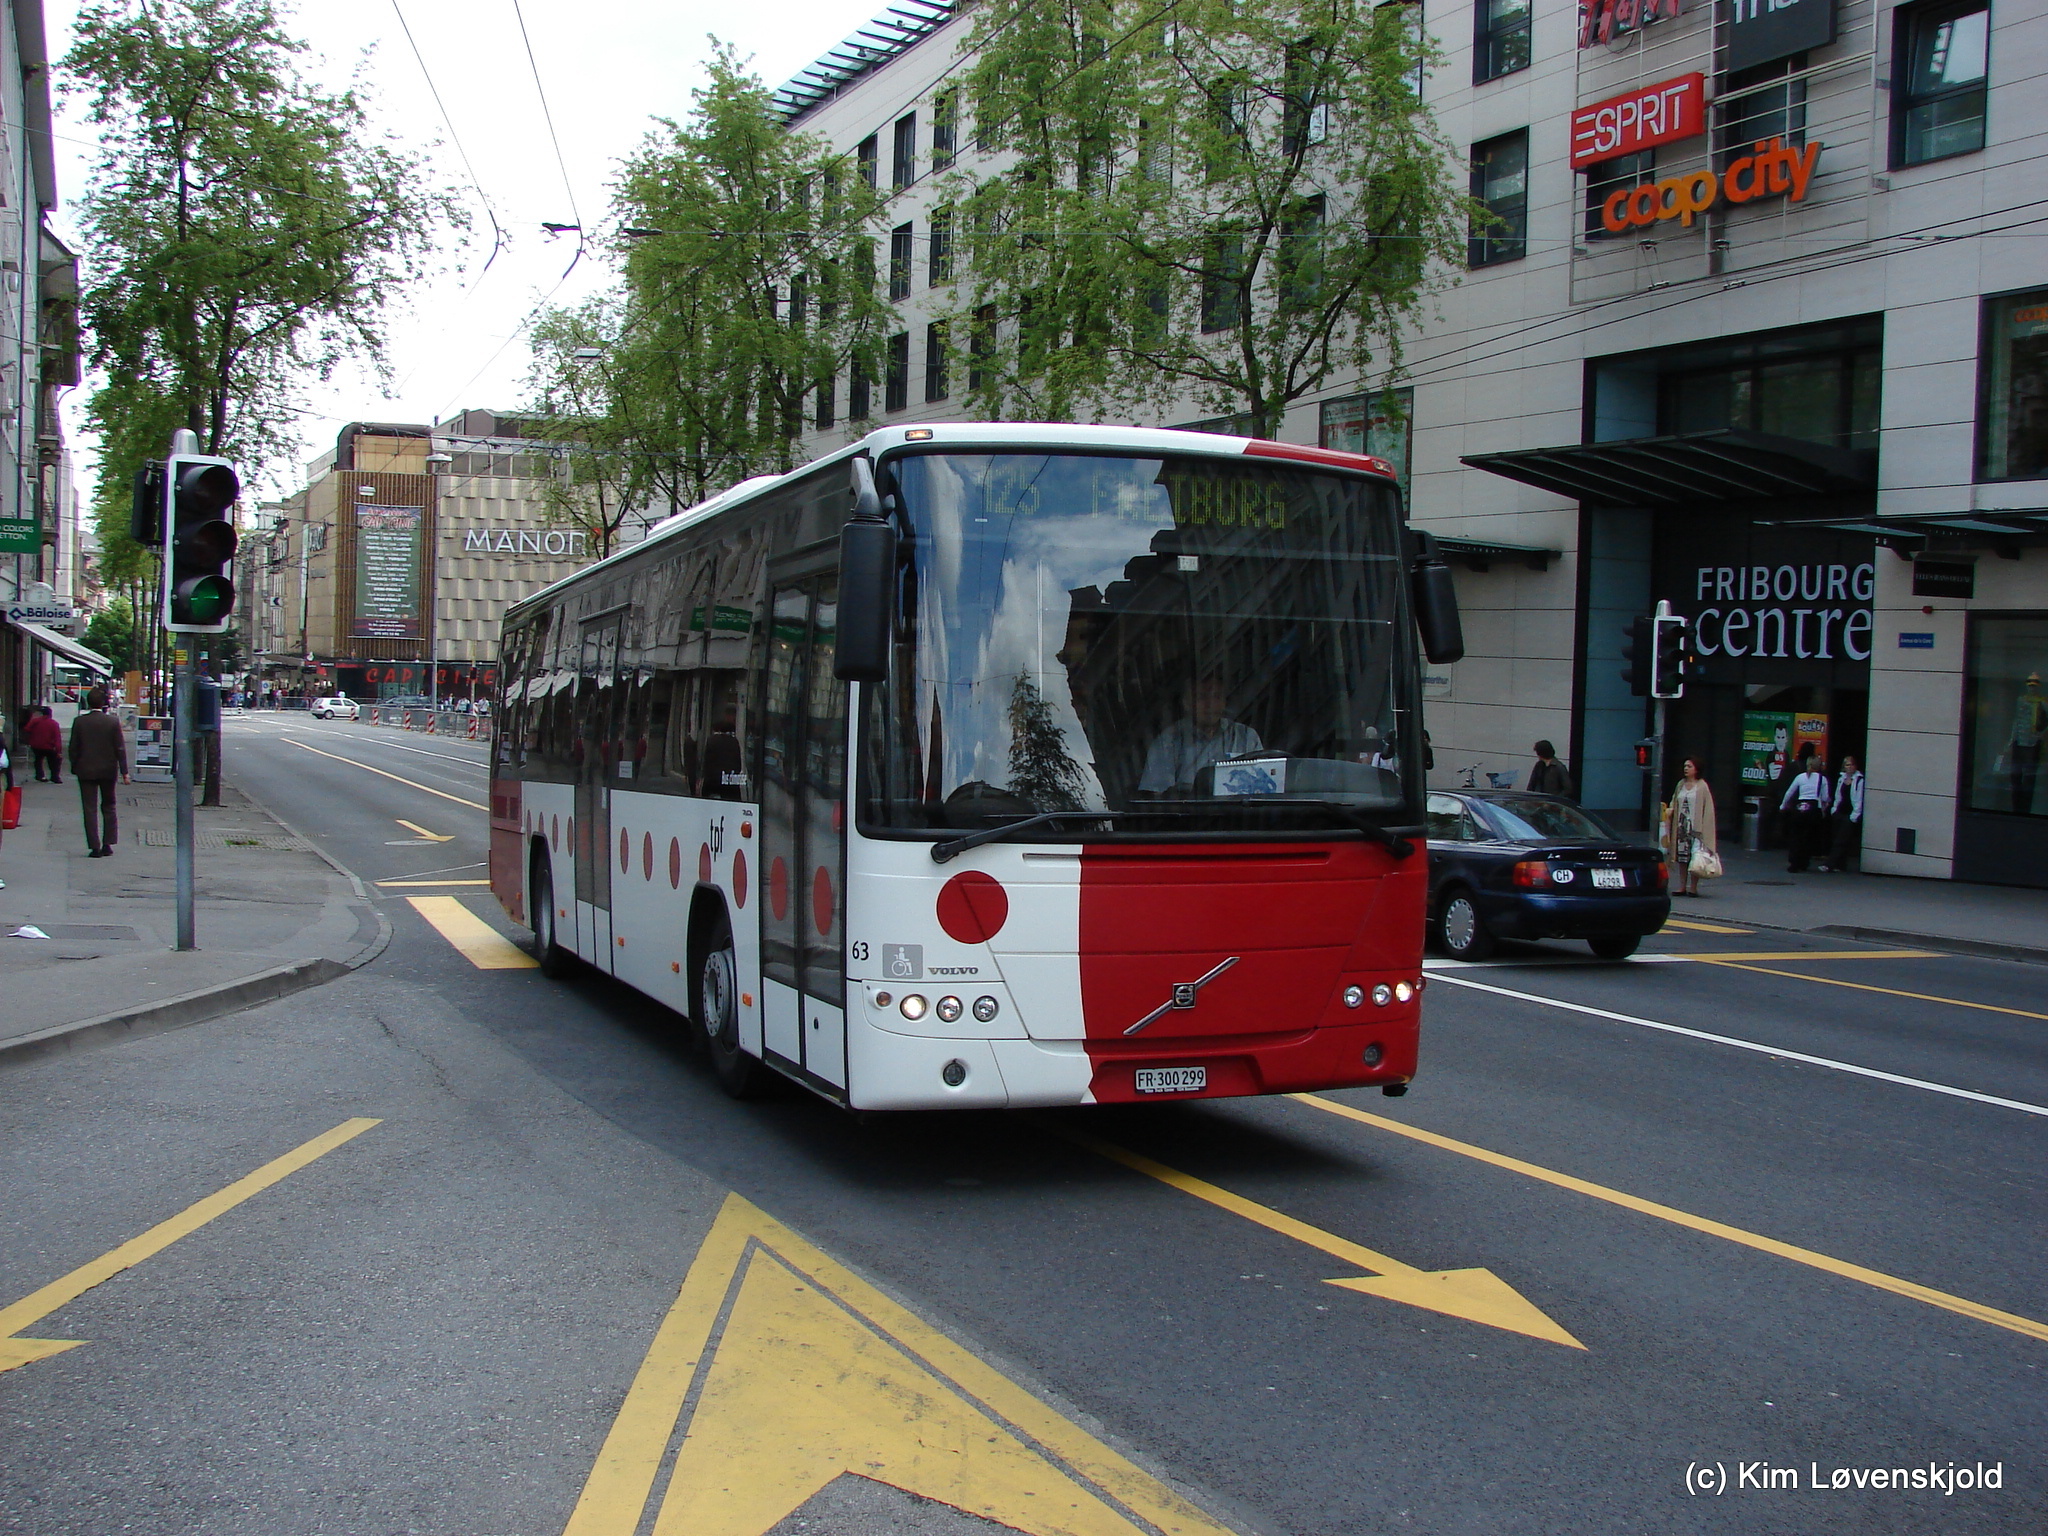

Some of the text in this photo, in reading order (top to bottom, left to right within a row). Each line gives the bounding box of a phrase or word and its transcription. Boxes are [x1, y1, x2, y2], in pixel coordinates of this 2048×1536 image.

[1575, 83, 1690, 159] ESPRIT
[1602, 136, 1823, 232] coop city
[3, 525, 34, 533] COLORS
[1697, 563, 1874, 601] FRIBOURG
[26, 607, 72, 619] Bâloise
[1695, 607, 1873, 661] centre
[710, 815, 725, 862] tpf
[1556, 870, 1569, 882] CH
[852, 940, 870, 961] 63
[928, 966, 979, 975] VOLVO
